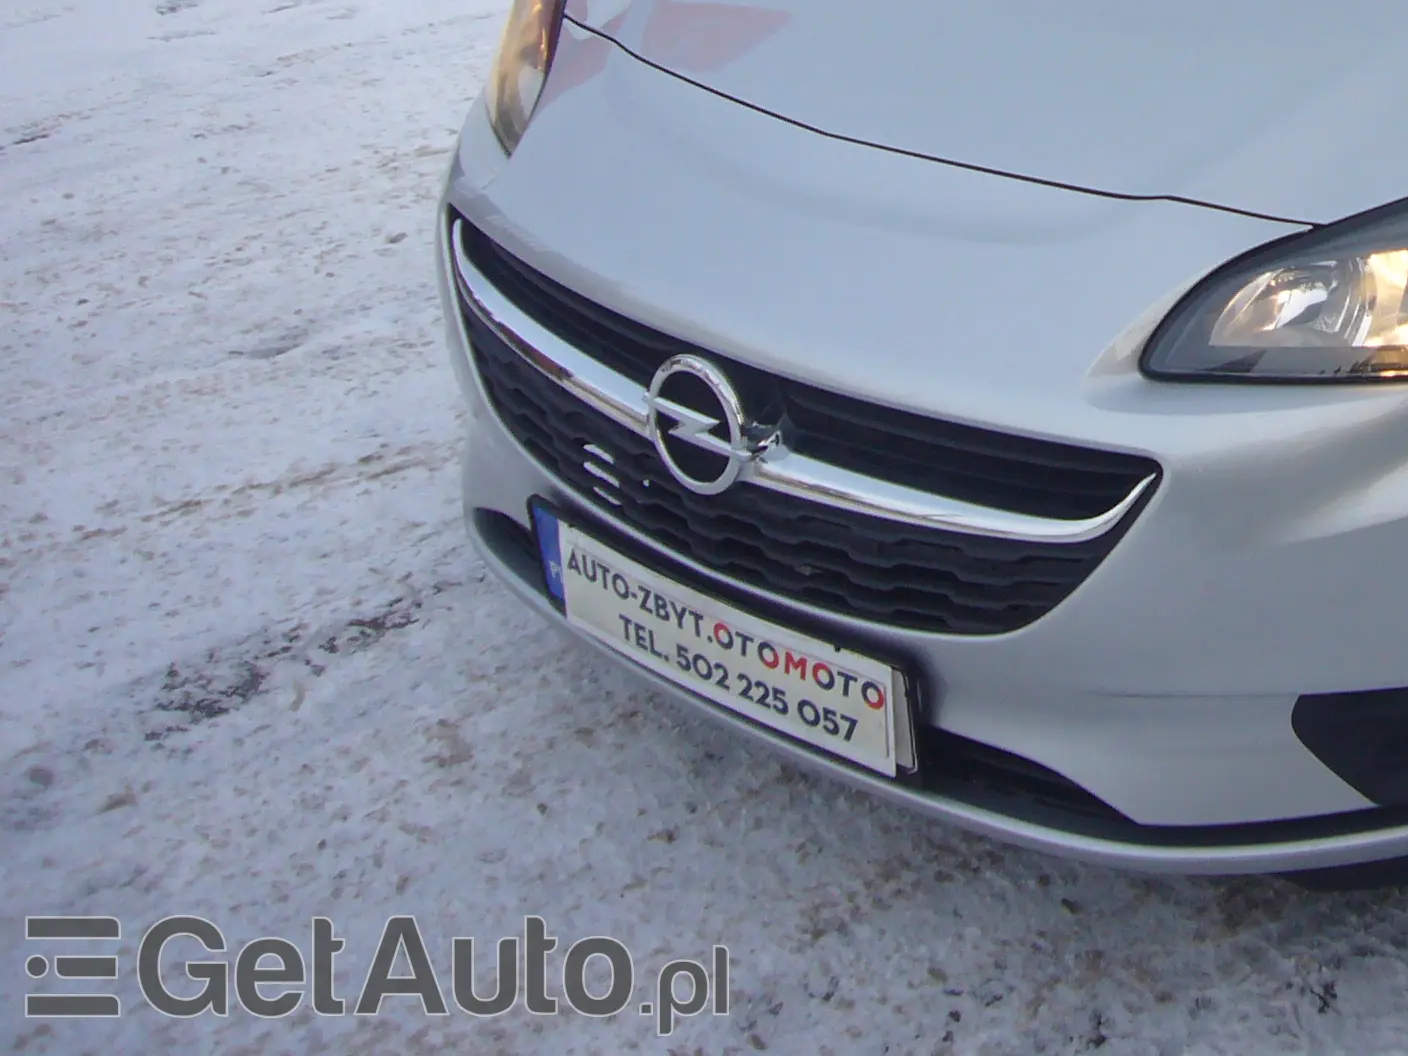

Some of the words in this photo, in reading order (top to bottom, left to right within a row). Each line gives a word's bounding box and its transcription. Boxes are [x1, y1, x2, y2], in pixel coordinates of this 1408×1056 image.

[618, 613, 669, 663] TEL.
[676, 643, 731, 692] 502
[736, 674, 790, 716] 225
[796, 698, 859, 743] 057
